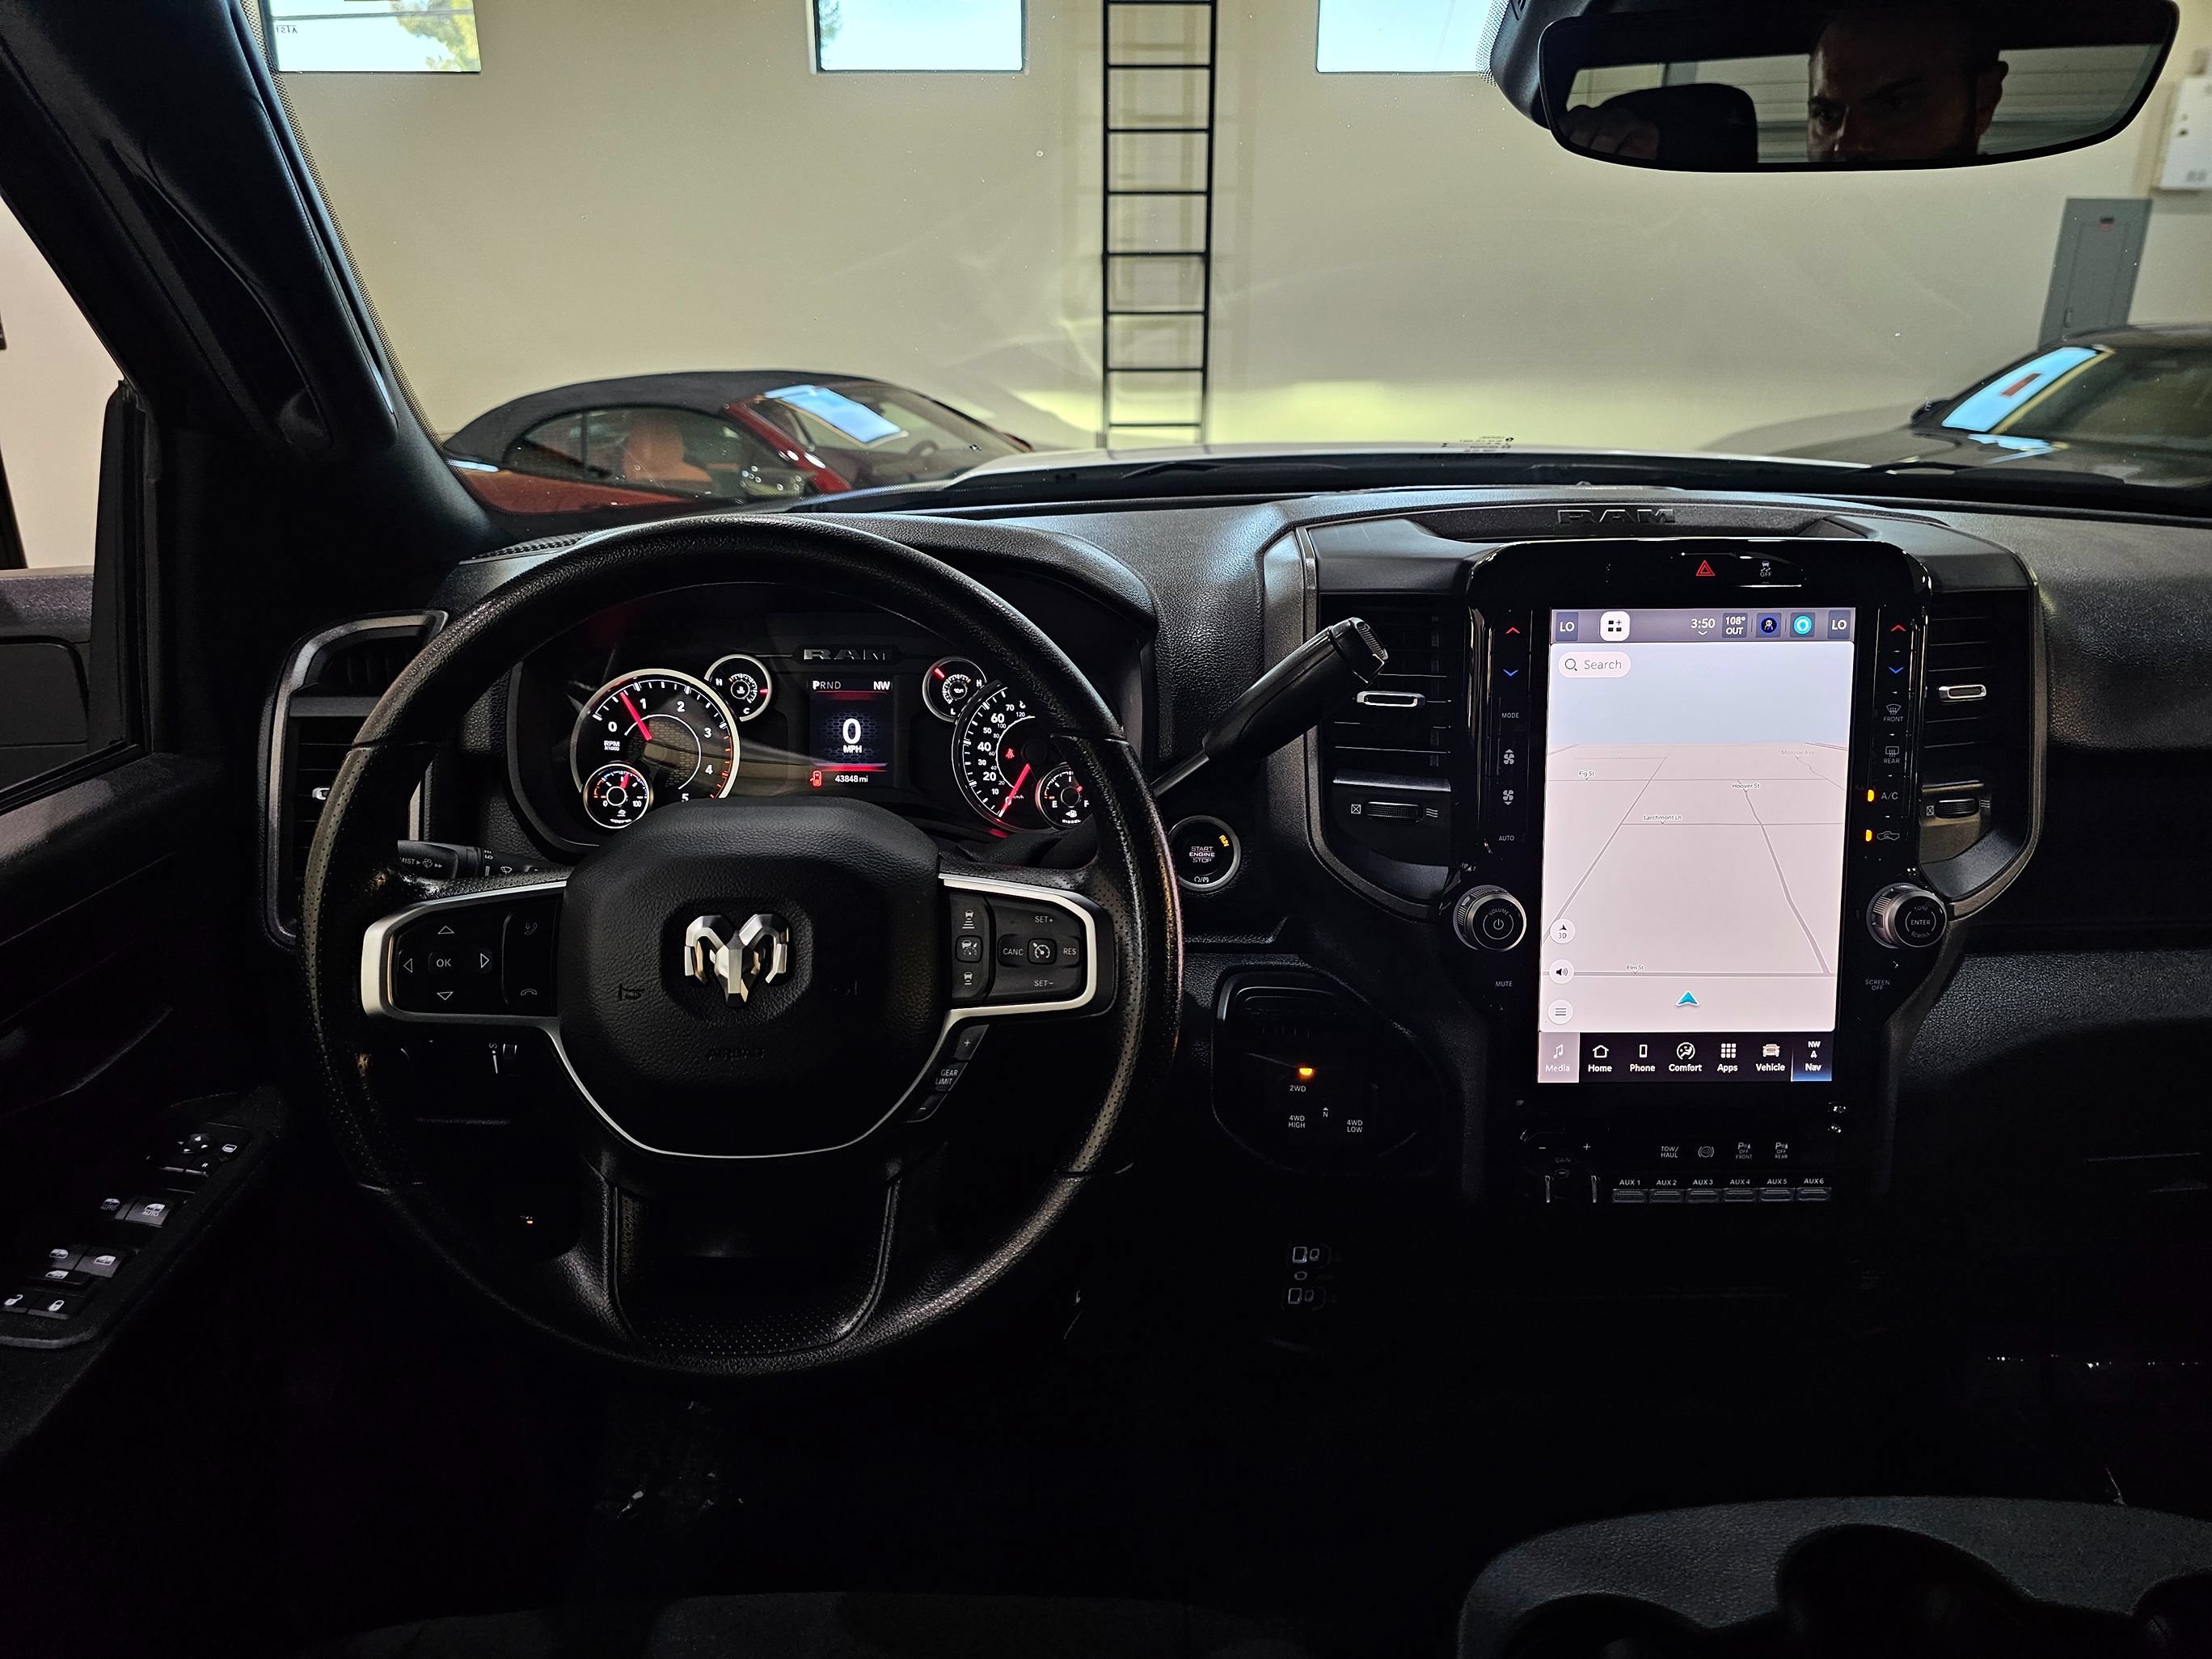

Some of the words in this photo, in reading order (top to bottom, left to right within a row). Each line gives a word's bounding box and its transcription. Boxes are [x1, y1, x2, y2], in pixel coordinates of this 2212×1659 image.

[1557, 509, 1676, 524] RAM
[1691, 618, 1715, 629] 3:50
[1726, 616, 1746, 626] 108°
[1831, 620, 1847, 631] LO
[1559, 621, 1576, 632] LO
[1726, 627, 1743, 635] OUT
[804, 649, 892, 660] RAM
[1585, 660, 1621, 669] Search
[874, 682, 890, 690] NW
[640, 699, 646, 709] 1
[678, 701, 685, 711] 2
[990, 713, 1005, 724] 60
[608, 721, 617, 732] 0
[842, 718, 862, 744] 0
[704, 728, 711, 737] 3
[842, 745, 862, 754] MPH
[977, 741, 991, 752] 40
[705, 765, 713, 775] 4
[834, 775, 859, 783] 43848
[859, 775, 869, 783] mi
[983, 771, 996, 781] 20
[1881, 792, 1898, 800] A/C
[1219, 835, 1229, 846] RUN
[1488, 907, 1510, 916] VOLUME
[437, 959, 451, 967] OK
[1545, 1064, 1570, 1072] Media
[1717, 1064, 1737, 1073] Apps
[1756, 1063, 1785, 1071] Vehicle
[1805, 1063, 1822, 1071] Nav
[940, 1069, 959, 1077] GEAR
[1289, 1115, 1305, 1123] 4WD
